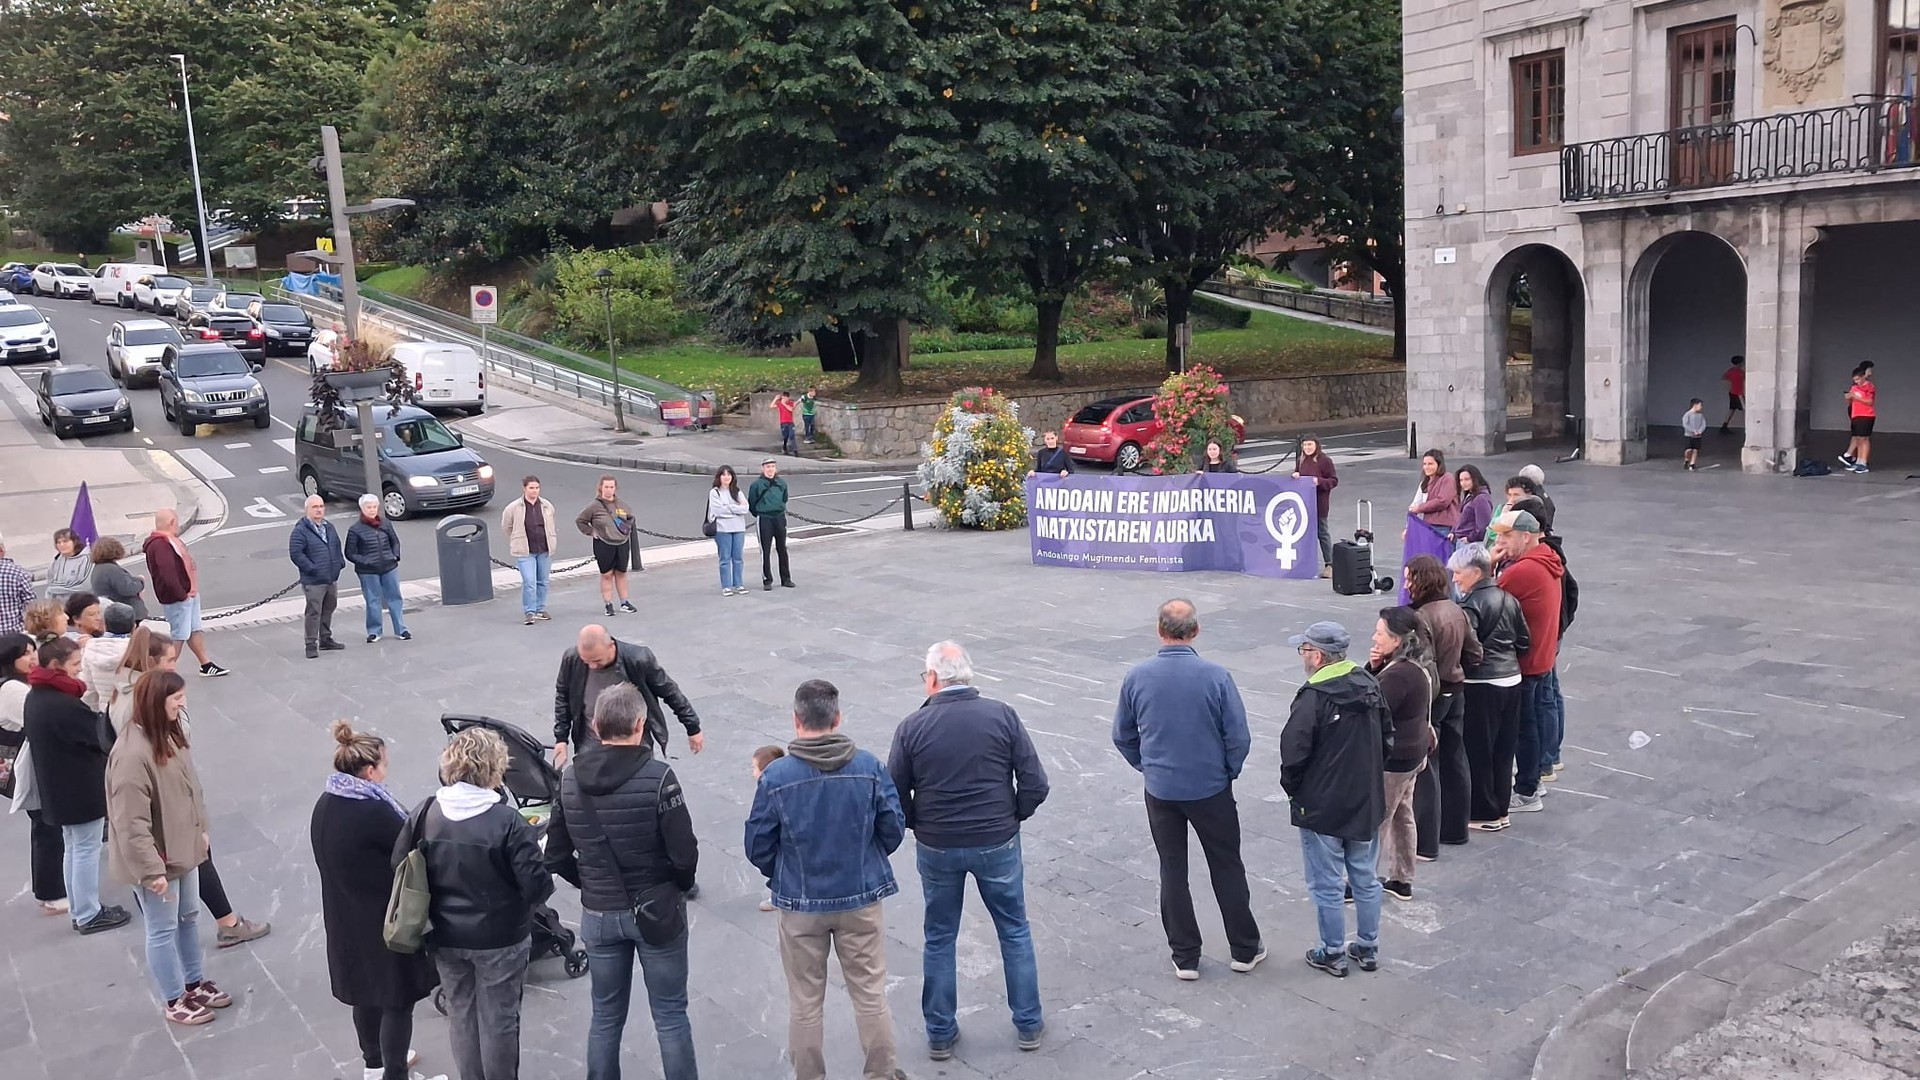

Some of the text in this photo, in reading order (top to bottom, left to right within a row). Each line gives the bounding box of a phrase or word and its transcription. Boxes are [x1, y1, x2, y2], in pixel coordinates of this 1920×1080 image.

[1035, 487, 1257, 515] ANDOAIN ERE INDARKERIA
[1036, 516, 1216, 544] MATXISTAREN AURKA
[1036, 549, 1184, 565] Andoaingo Mugimendu Feminista
